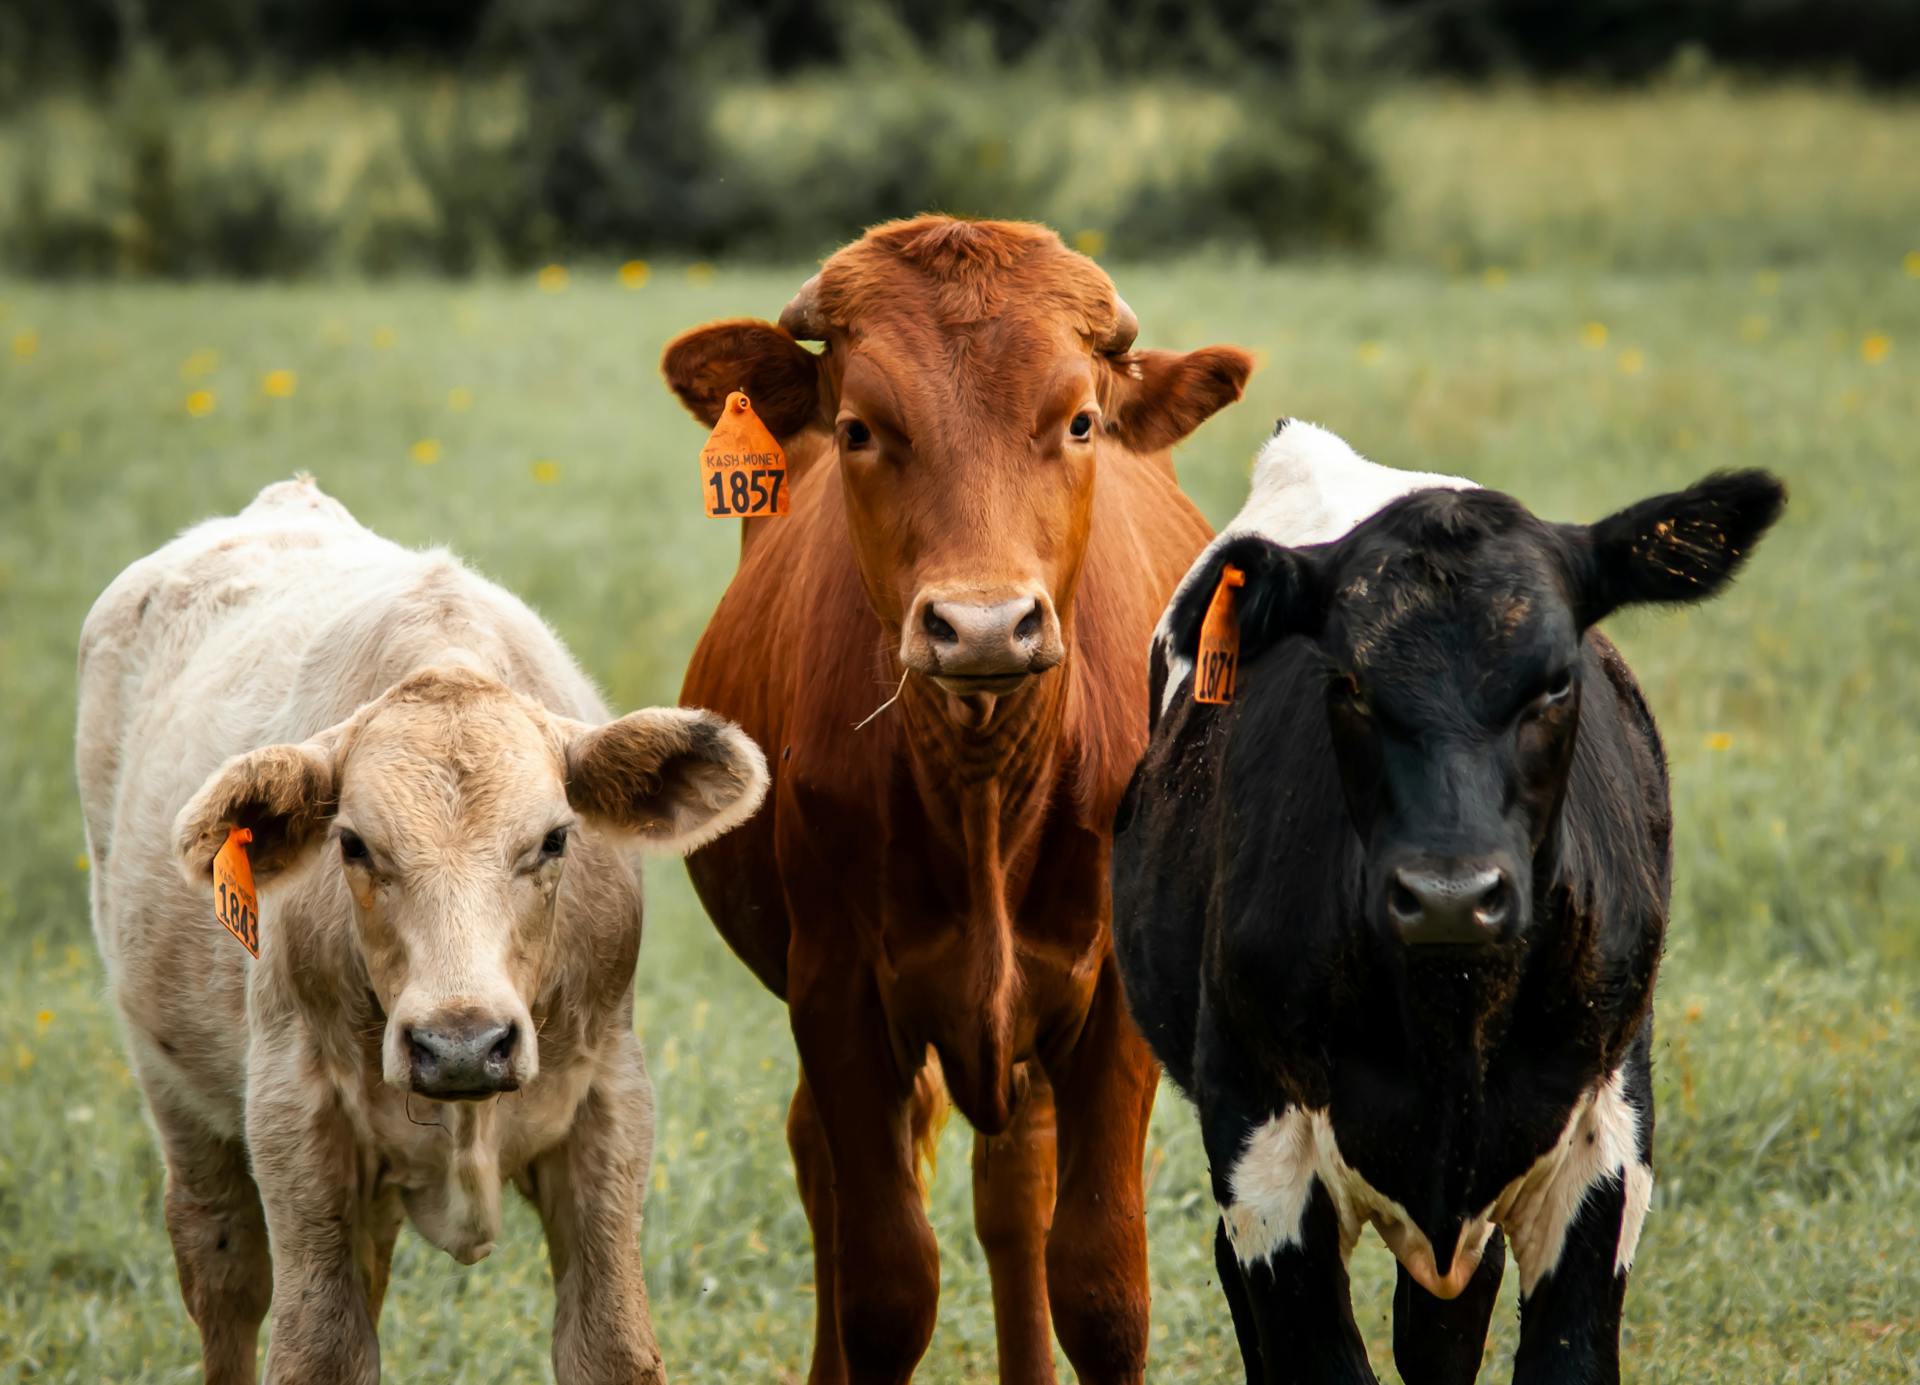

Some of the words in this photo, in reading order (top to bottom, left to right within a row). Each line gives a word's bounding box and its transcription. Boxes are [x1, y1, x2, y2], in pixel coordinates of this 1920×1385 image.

[706, 454, 740, 467] KASH
[743, 453, 780, 466] MONEY
[709, 469, 785, 515] 1857
[1200, 650, 1234, 701] 1871
[219, 883, 259, 952] 1843
